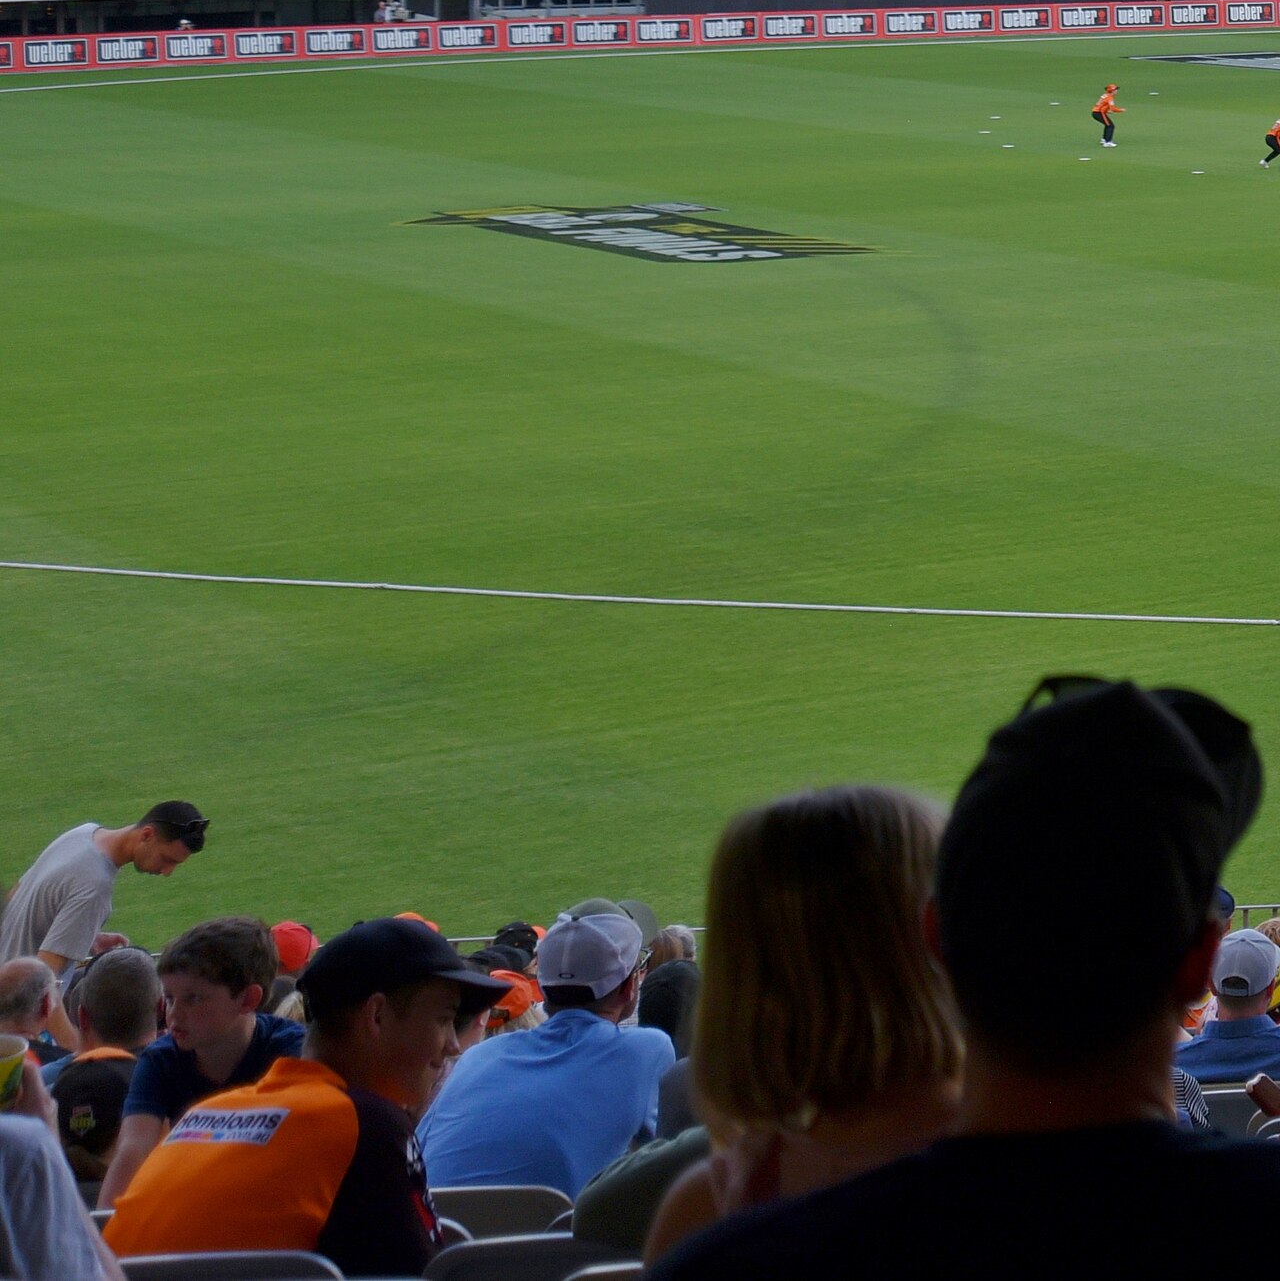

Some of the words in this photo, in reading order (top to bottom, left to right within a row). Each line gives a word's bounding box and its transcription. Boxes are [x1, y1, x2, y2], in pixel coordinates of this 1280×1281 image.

[887, 13, 925, 32] weber
[945, 11, 982, 30] weber
[1002, 9, 1038, 29] weber
[1061, 8, 1098, 27] weber
[1117, 7, 1152, 25] weber
[1172, 5, 1208, 23] weber
[1229, 4, 1263, 22] weber
[511, 24, 553, 44] weber
[576, 23, 618, 42] weber
[640, 20, 679, 40] weber
[705, 18, 745, 38] weber
[766, 16, 805, 35] weber
[825, 15, 863, 34] weber
[238, 34, 281, 54] weber
[309, 32, 352, 51] weber
[375, 30, 417, 50] weber
[442, 28, 484, 47] weber
[28, 44, 71, 63] weber
[100, 40, 143, 60] weber
[169, 38, 212, 57] weber
[549, 227, 783, 261] FINALS
